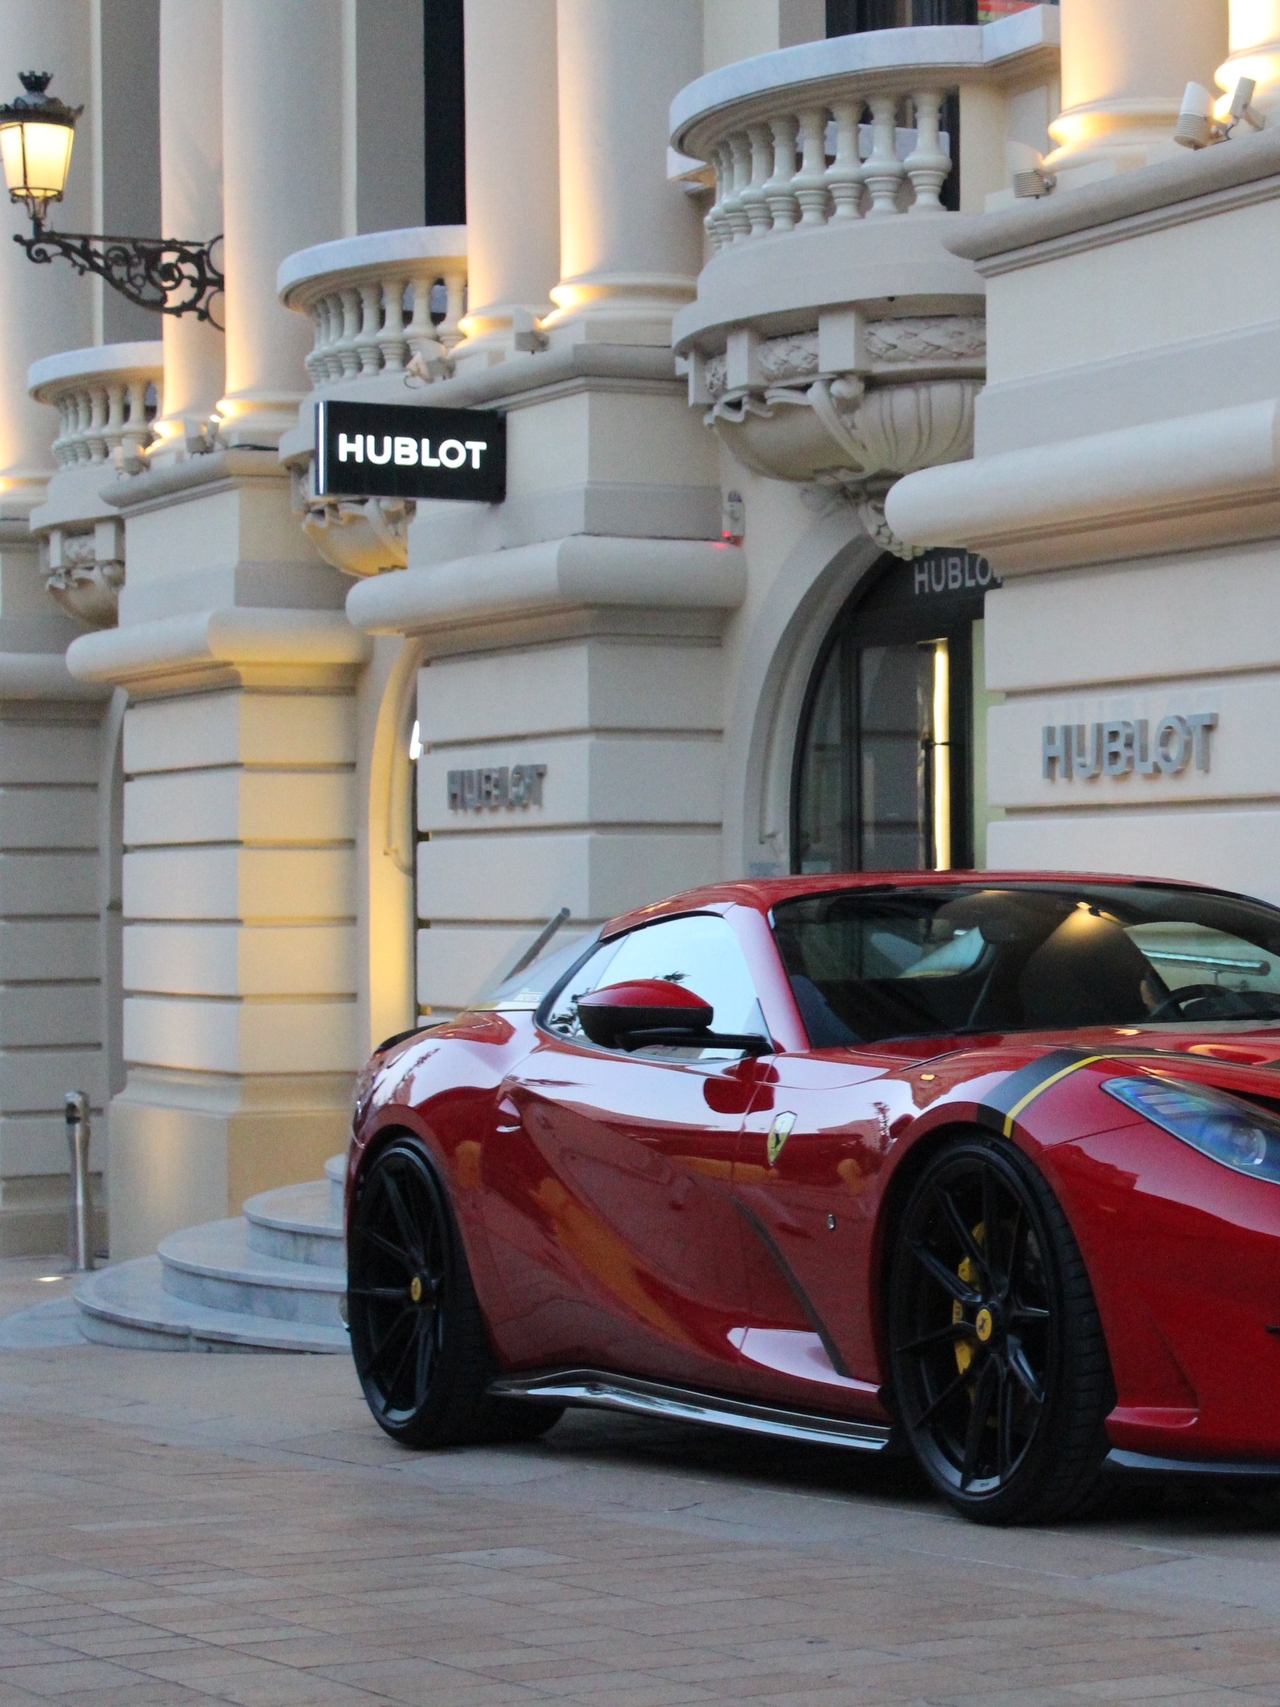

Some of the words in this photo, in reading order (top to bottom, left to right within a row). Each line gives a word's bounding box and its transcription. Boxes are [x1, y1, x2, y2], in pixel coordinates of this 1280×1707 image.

[338, 433, 488, 470] HUBLOT
[914, 554, 1002, 595] HUBLO
[1042, 712, 1219, 782] HUBLOT
[446, 763, 548, 812] HUBLOT
